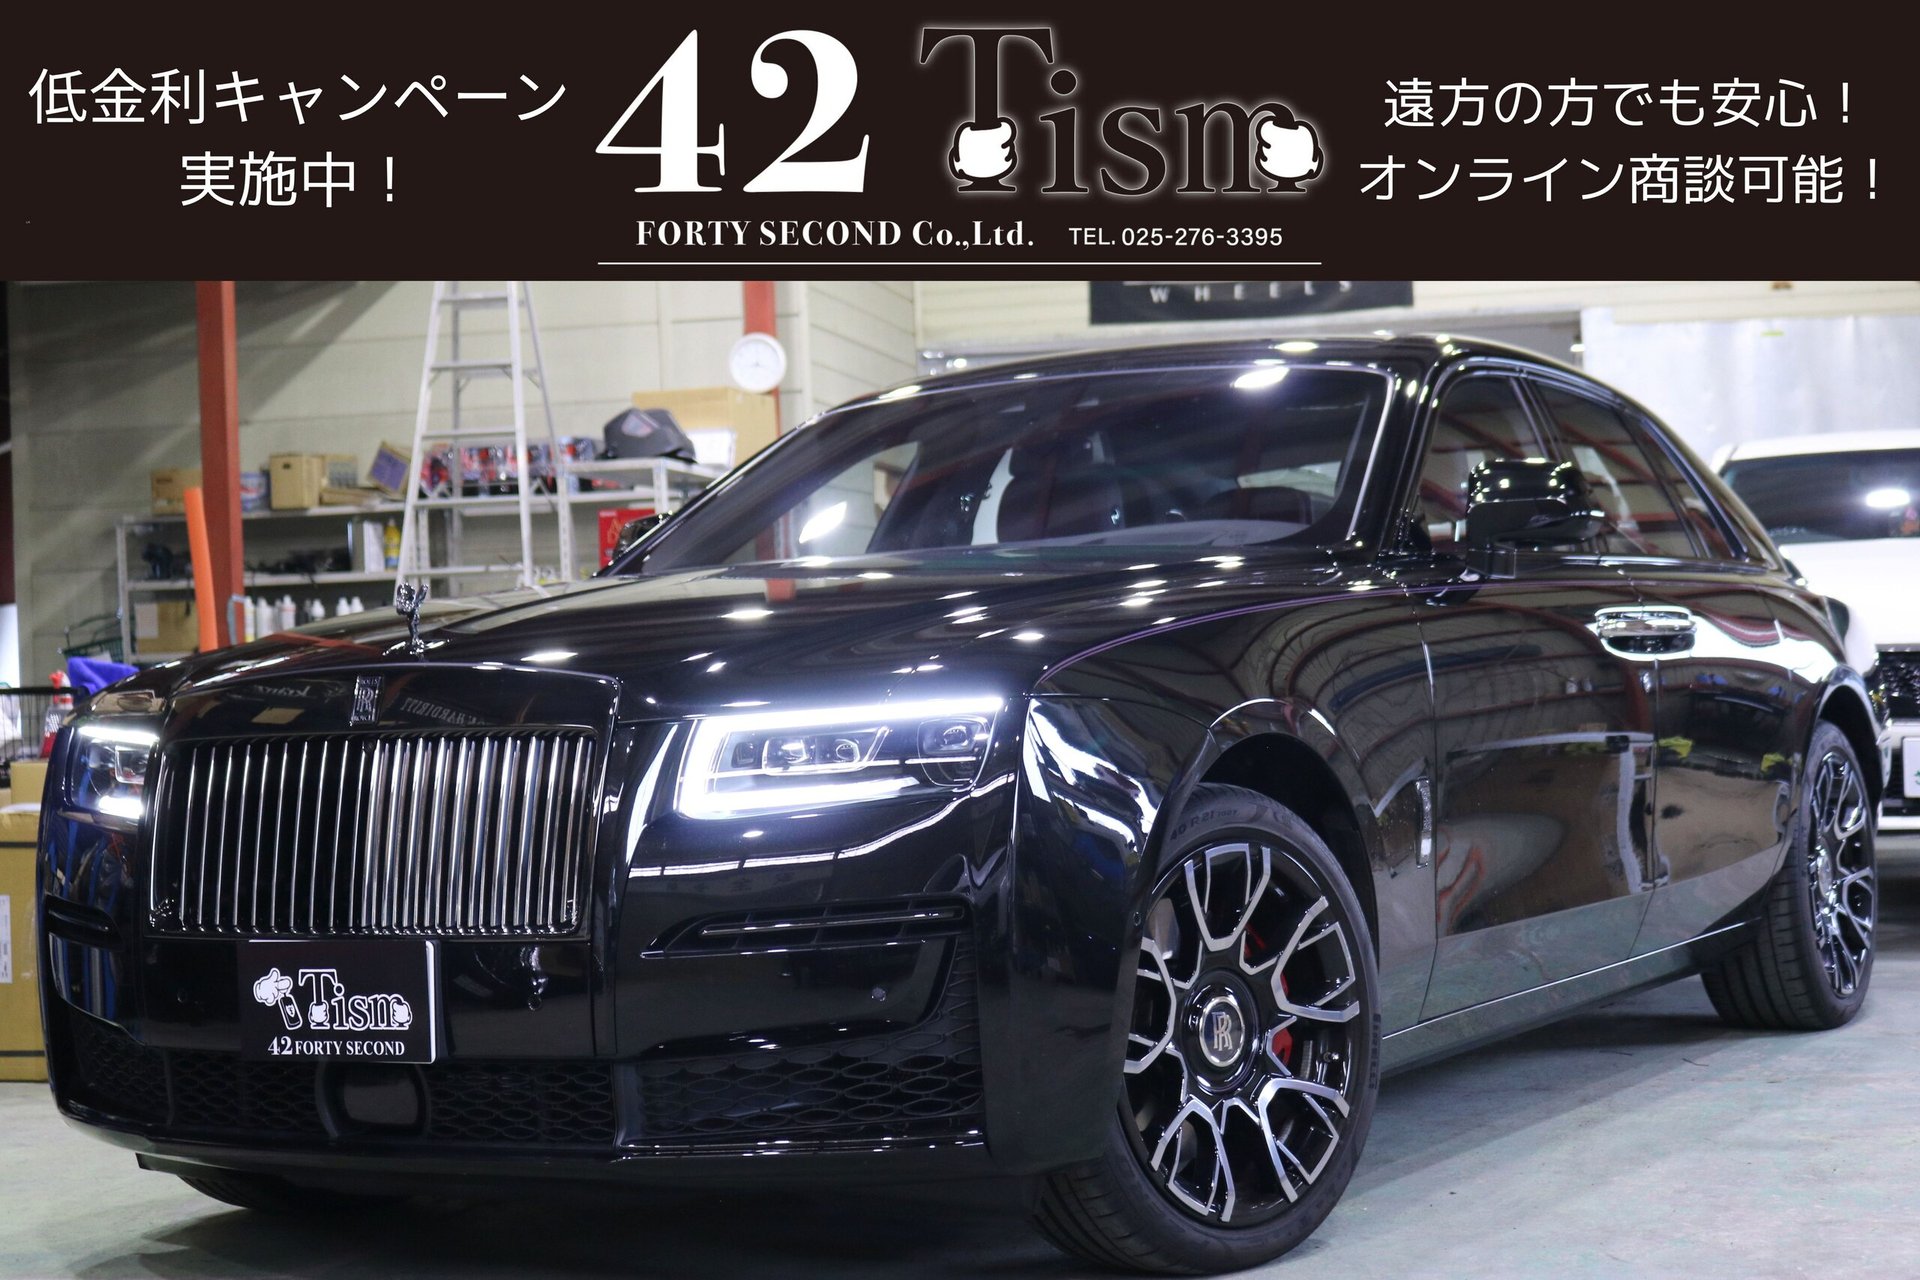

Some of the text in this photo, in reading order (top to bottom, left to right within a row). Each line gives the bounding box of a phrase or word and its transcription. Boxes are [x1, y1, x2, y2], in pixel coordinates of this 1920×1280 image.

[1150, 281, 1352, 303] WHEELS
[298, 968, 413, 1031] Tism
[268, 1036, 405, 1055] 42 FORTY SECOND
